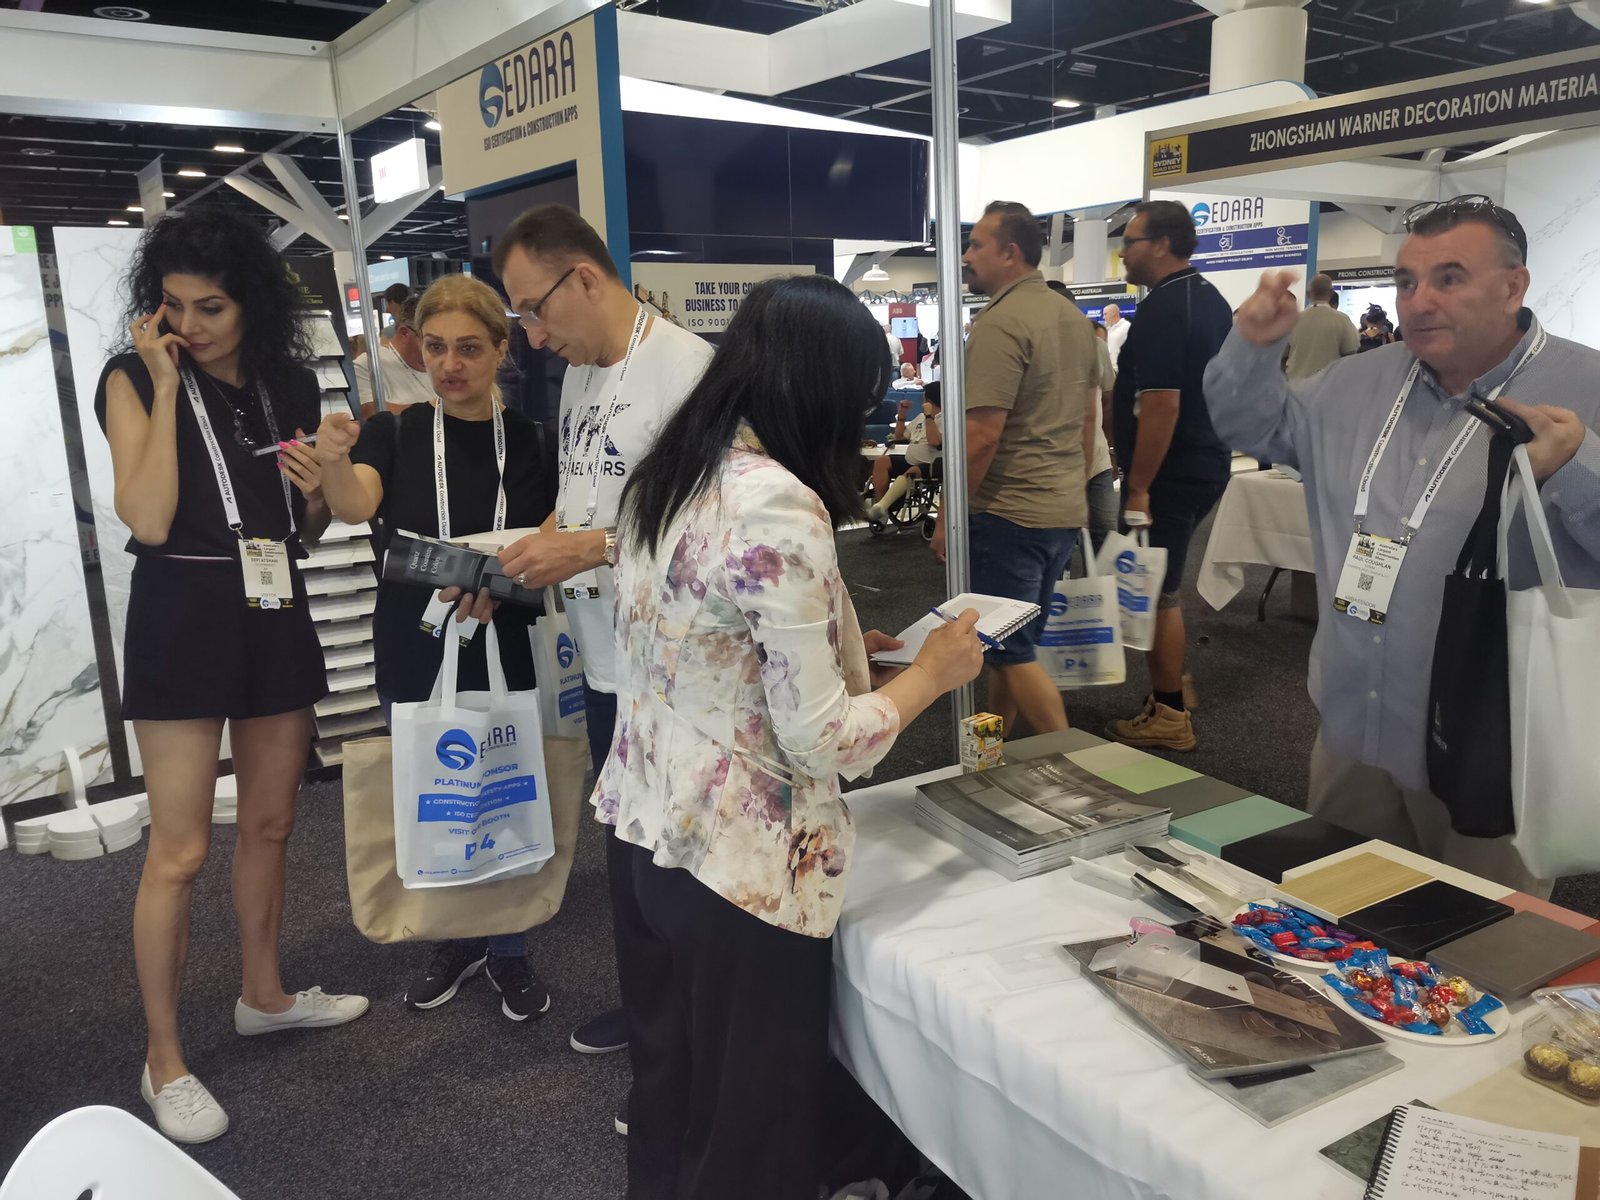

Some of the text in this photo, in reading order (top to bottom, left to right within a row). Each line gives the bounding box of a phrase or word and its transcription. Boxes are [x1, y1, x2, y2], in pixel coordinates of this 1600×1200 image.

[502, 31, 576, 118] EDARA
[1249, 73, 1600, 152] ZHONGSHAN WARNER DECORATION MATERIA
[491, 125, 523, 149] CERTIFICATION
[527, 110, 564, 137] CONSTRUCTION
[564, 105, 578, 123] APPS
[1153, 158, 1181, 168] SYDNEY
[1211, 196, 1264, 224] EDARA
[1226, 223, 1252, 231] CONSTRUCTION
[695, 281, 716, 295] TAKE
[718, 282, 740, 295] YOUR
[685, 298, 738, 312] BUSINESS TO
[688, 318, 704, 327] ISO
[602, 402, 615, 434] AUTODESK
[496, 428, 504, 455] AUTODESK
[1360, 404, 1401, 493] AUTODESK Construction Cloud
[200, 415, 233, 497] AUTODESK Construction Cloud
[1428, 418, 1479, 494] AUTODESK Construction
[437, 461, 445, 489] AUTODESK
[409, 551, 420, 570] Quartz
[1352, 554, 1392, 570] PAUL COUGHLAN
[482, 763, 519, 778] ONSOR
[448, 828, 469, 836] VISIT
[481, 813, 511, 827] BOOTH
